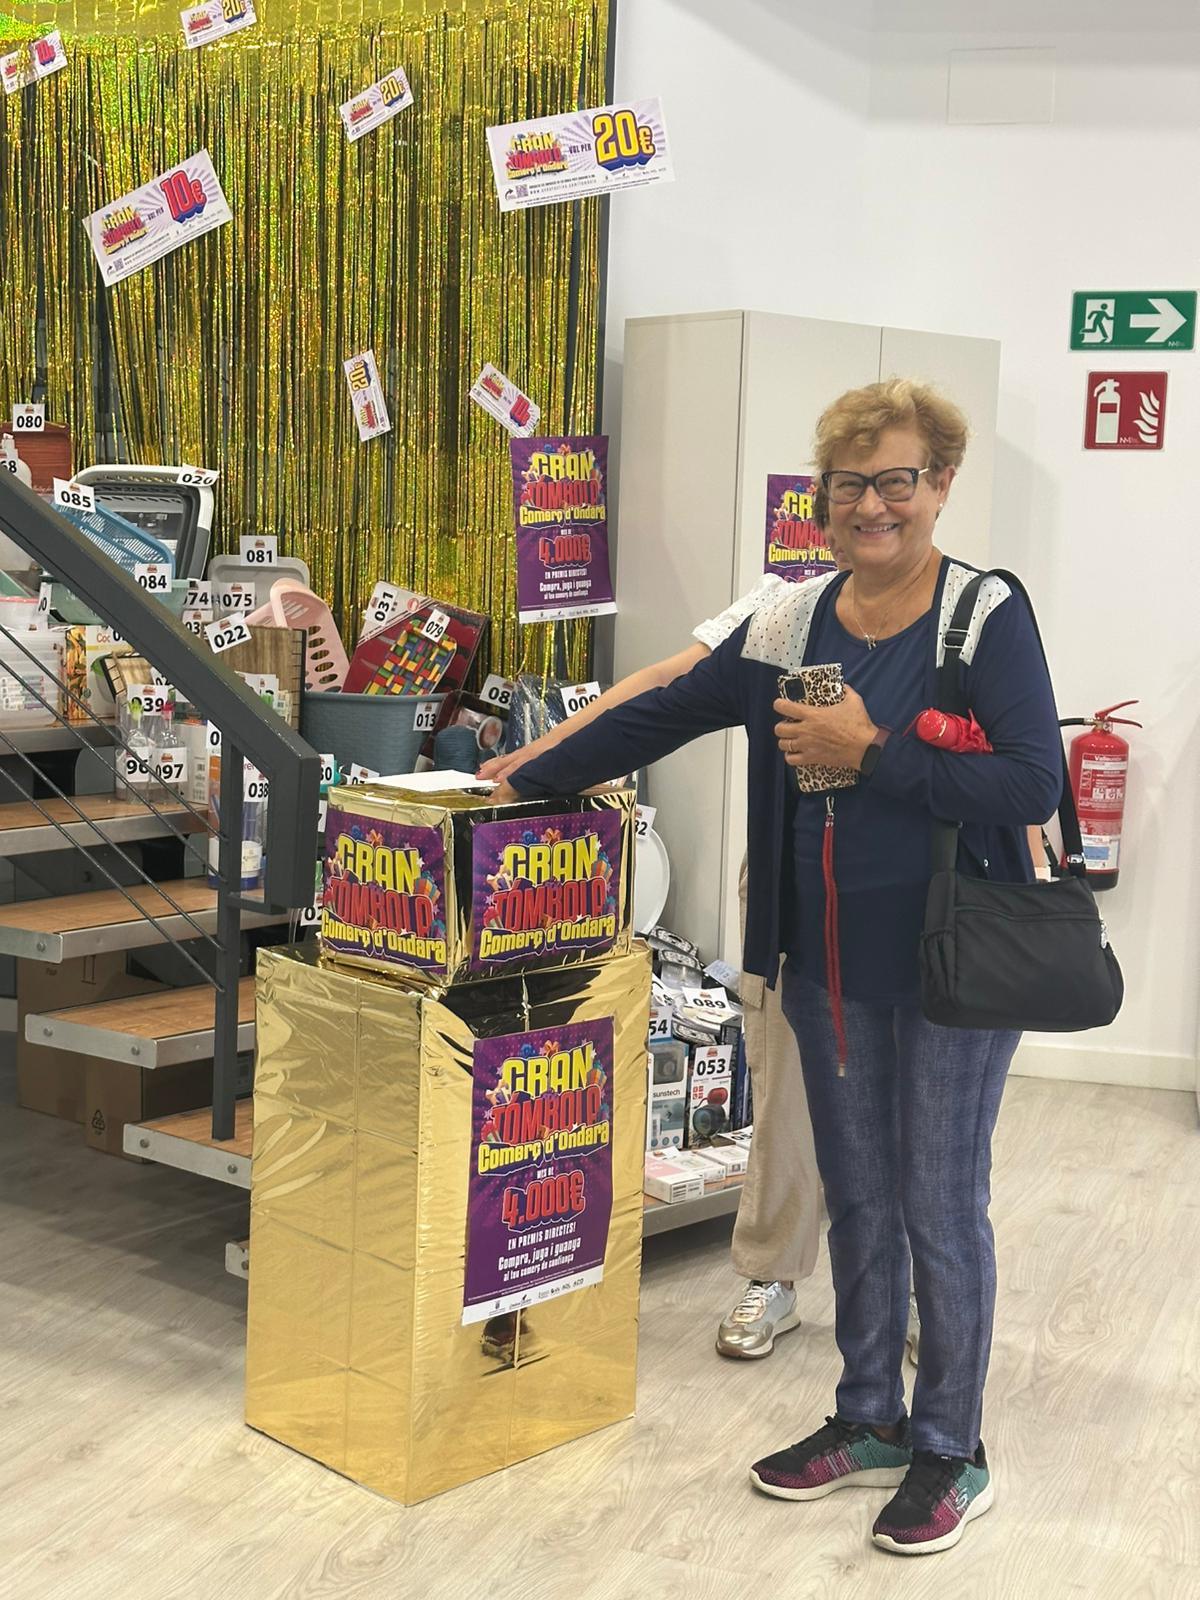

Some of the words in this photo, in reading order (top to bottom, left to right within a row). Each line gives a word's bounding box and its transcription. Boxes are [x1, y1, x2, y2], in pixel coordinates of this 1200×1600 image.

[592, 109, 656, 166] 20€
[160, 170, 207, 221] 10€
[16, 415, 43, 428] 080
[532, 450, 594, 482] GRAN
[181, 473, 214, 485] 020
[60, 490, 92, 508] 085
[783, 490, 813, 519] GR
[520, 506, 563, 525] Comerç
[246, 550, 273, 563] 081
[139, 575, 167, 589] 084
[184, 592, 208, 605] 74
[223, 593, 252, 607] 075
[374, 591, 393, 622] 031
[214, 625, 247, 648] 022
[425, 620, 444, 638] 079
[488, 687, 511, 704] 08
[416, 713, 436, 727] 013
[338, 834, 421, 896] GRAN
[504, 833, 599, 887] GRAN
[321, 909, 371, 948] Comerç
[373, 928, 447, 964] d'Ondara
[480, 929, 543, 958] Comerç
[546, 915, 616, 943] d'Ondara
[692, 998, 726, 1009] 089
[649, 1020, 668, 1035] 54
[502, 1043, 593, 1099] GRAN
[696, 1058, 726, 1076] 053
[653, 1088, 680, 1098] sunstech
[479, 1142, 542, 1173] Comerç
[545, 1122, 610, 1153] d'Ondara
[503, 1170, 585, 1227] 4.000€
[498, 1252, 531, 1271] Compra,
